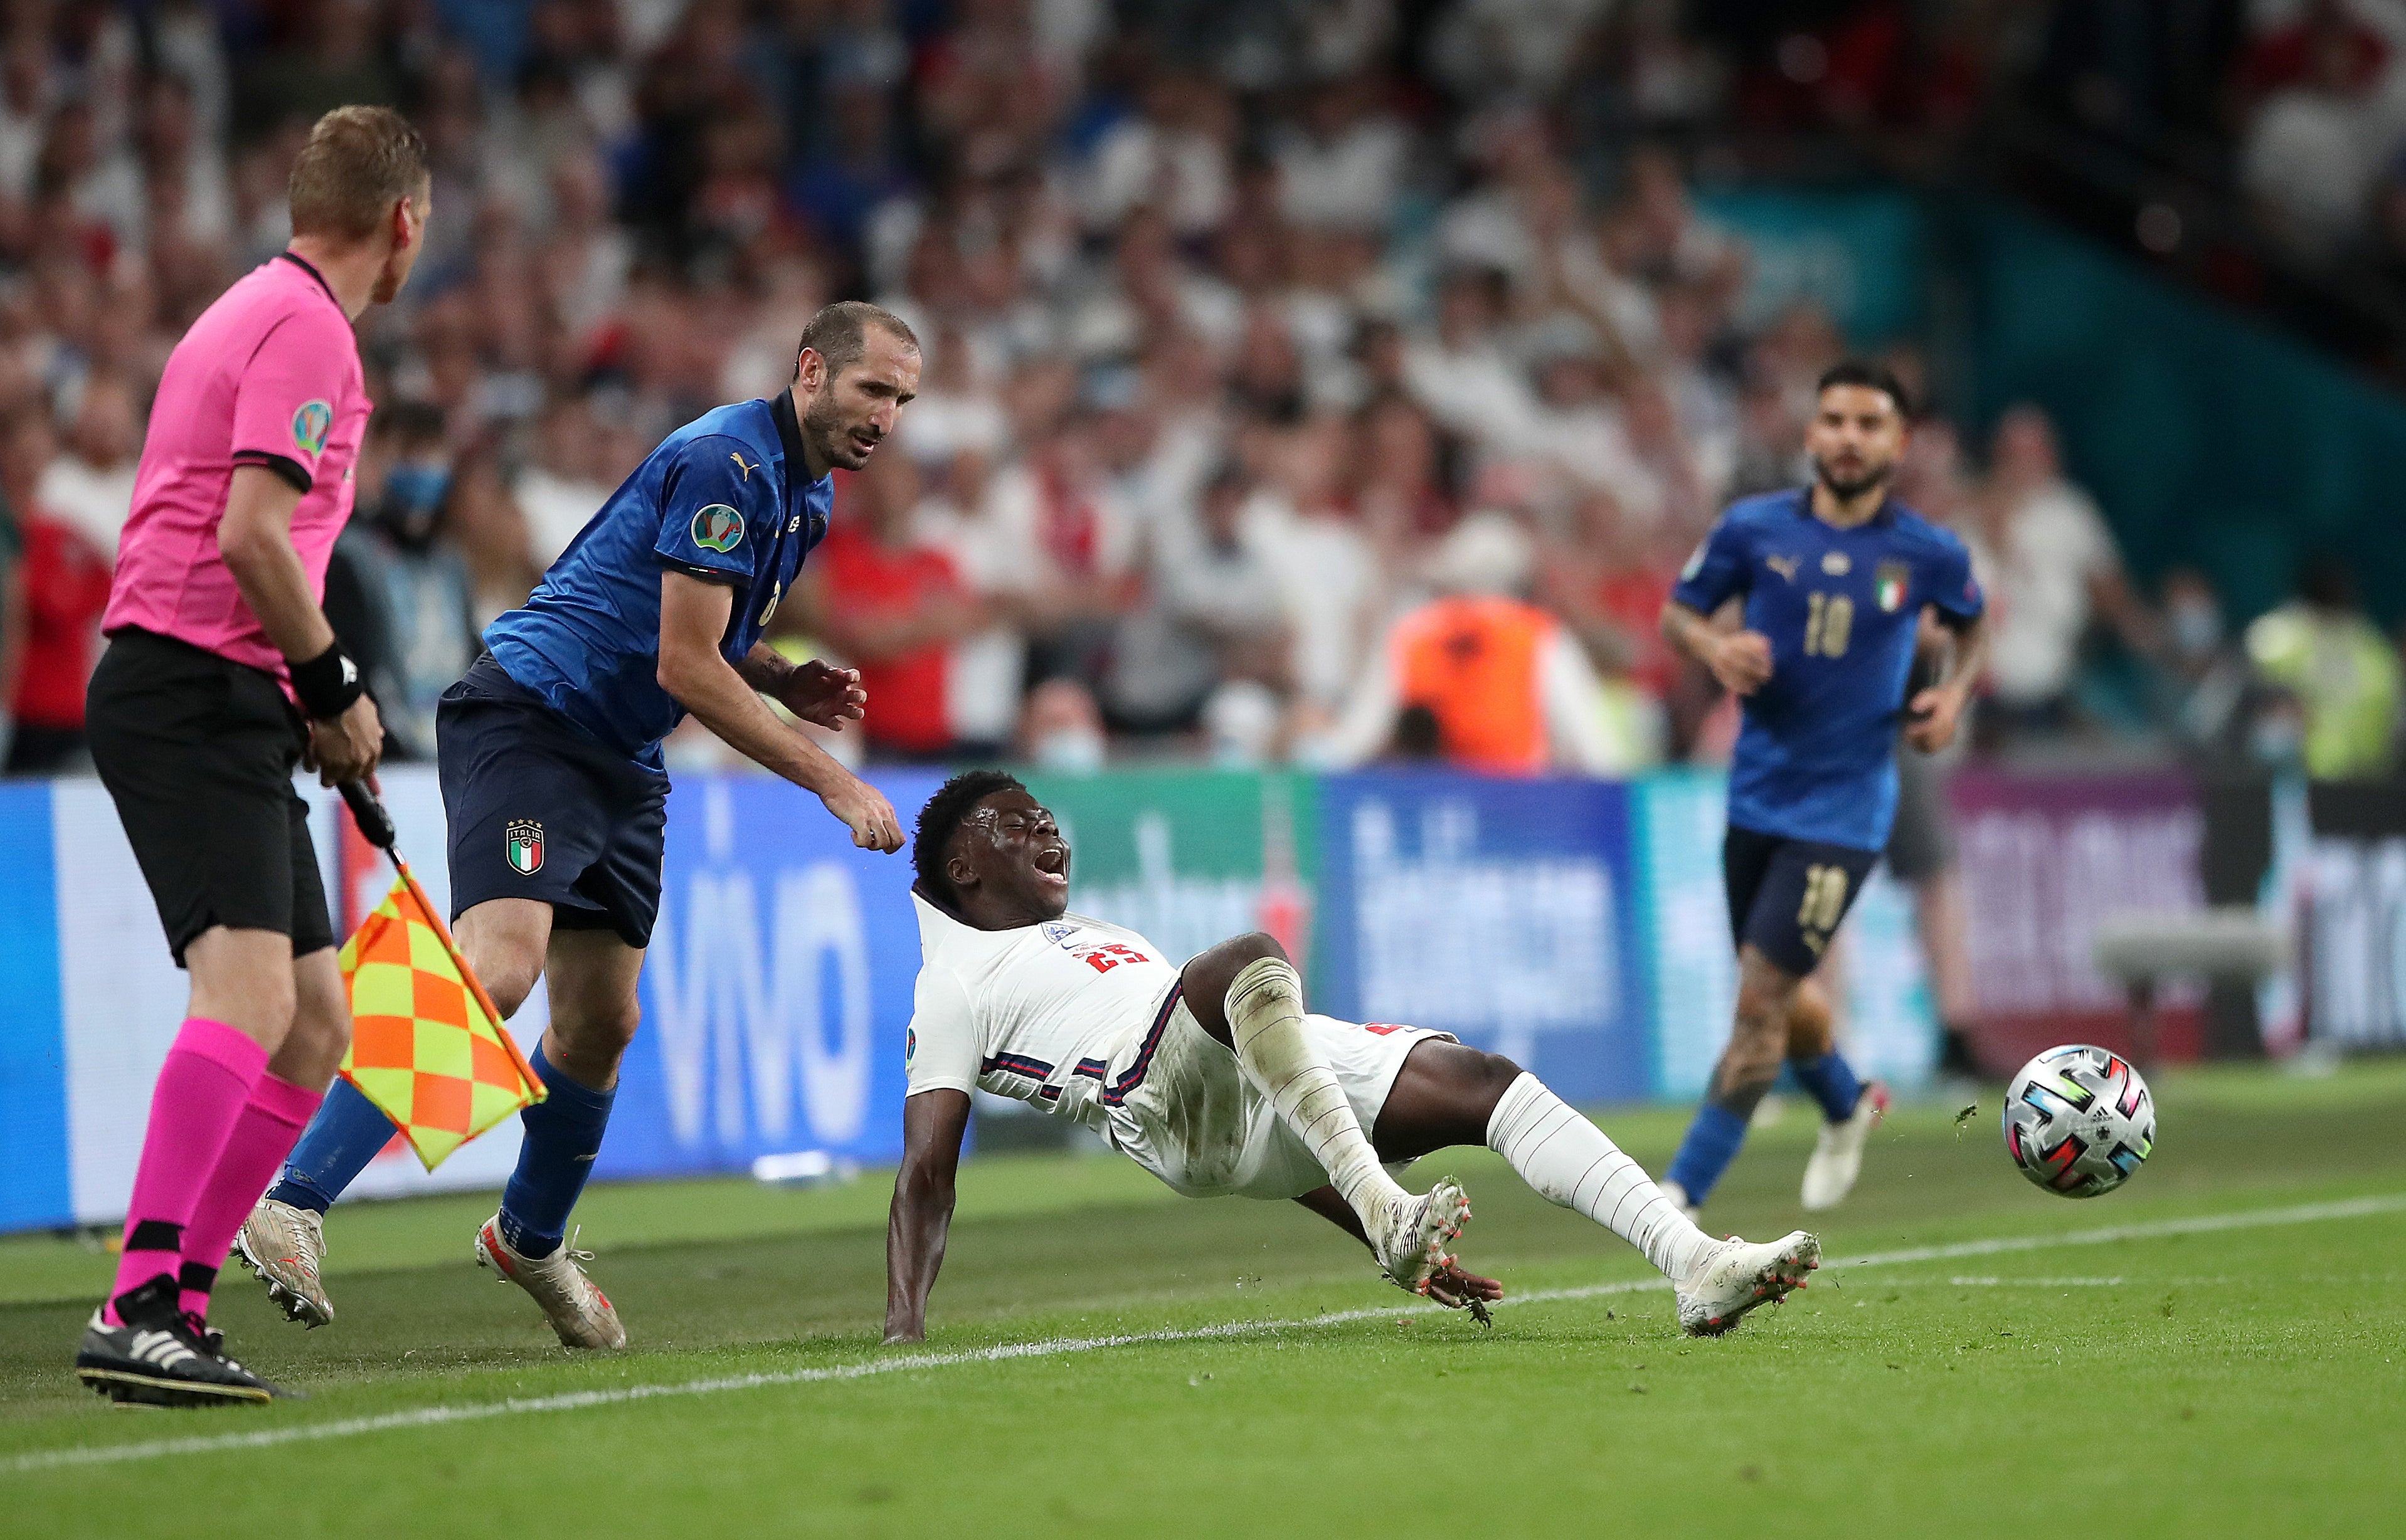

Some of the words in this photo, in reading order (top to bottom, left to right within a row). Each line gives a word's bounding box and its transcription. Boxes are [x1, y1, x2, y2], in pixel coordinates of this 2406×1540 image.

[1803, 589, 1855, 658] 10
[510, 830, 541, 839] ITALIA
[1797, 863, 1849, 931] 10
[1072, 944, 1150, 974] 25
